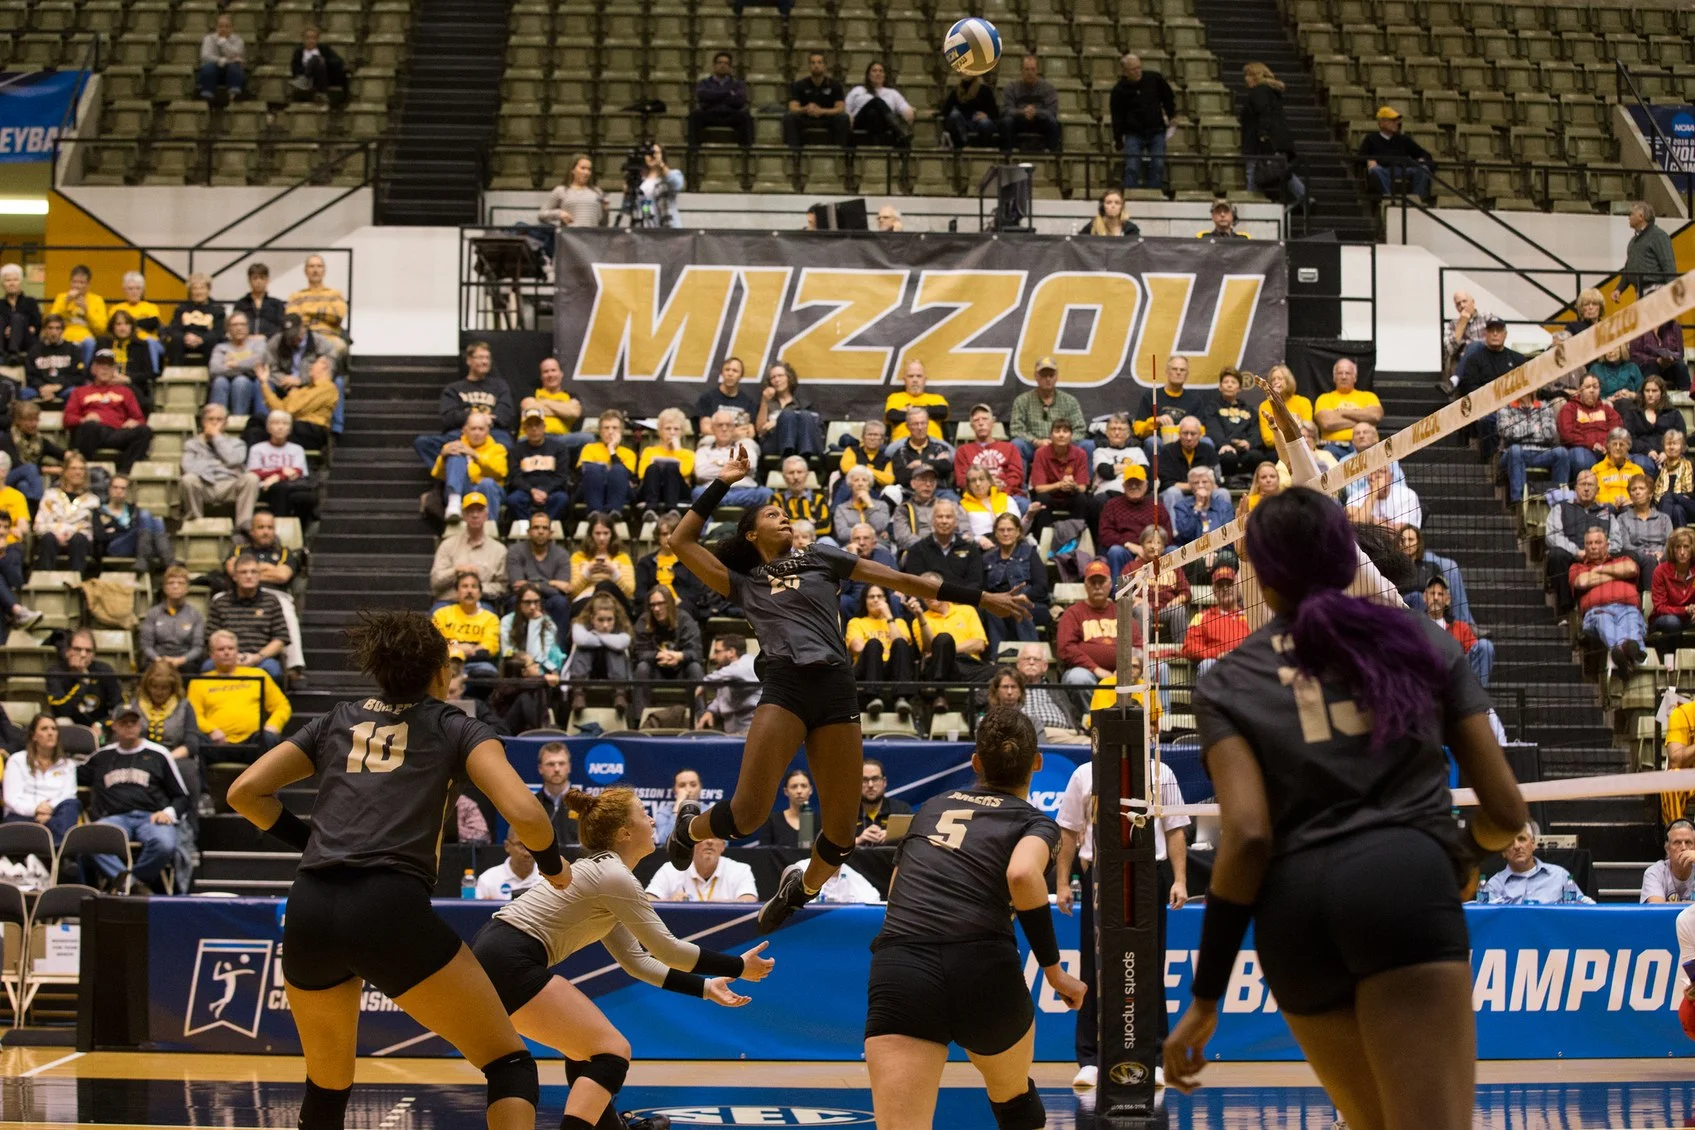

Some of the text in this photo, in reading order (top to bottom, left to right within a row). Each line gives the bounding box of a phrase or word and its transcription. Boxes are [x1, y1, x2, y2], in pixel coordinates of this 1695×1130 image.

[0, 126, 68, 152] EYBA
[573, 263, 1265, 389] MIZZOU
[346, 721, 409, 773] 10
[588, 762, 625, 775] NCAA
[927, 809, 976, 850] 5
[1122, 951, 1137, 1050] sports imports
[1471, 948, 1681, 1012] AMPIO
[657, 1106, 858, 1125] SEC
